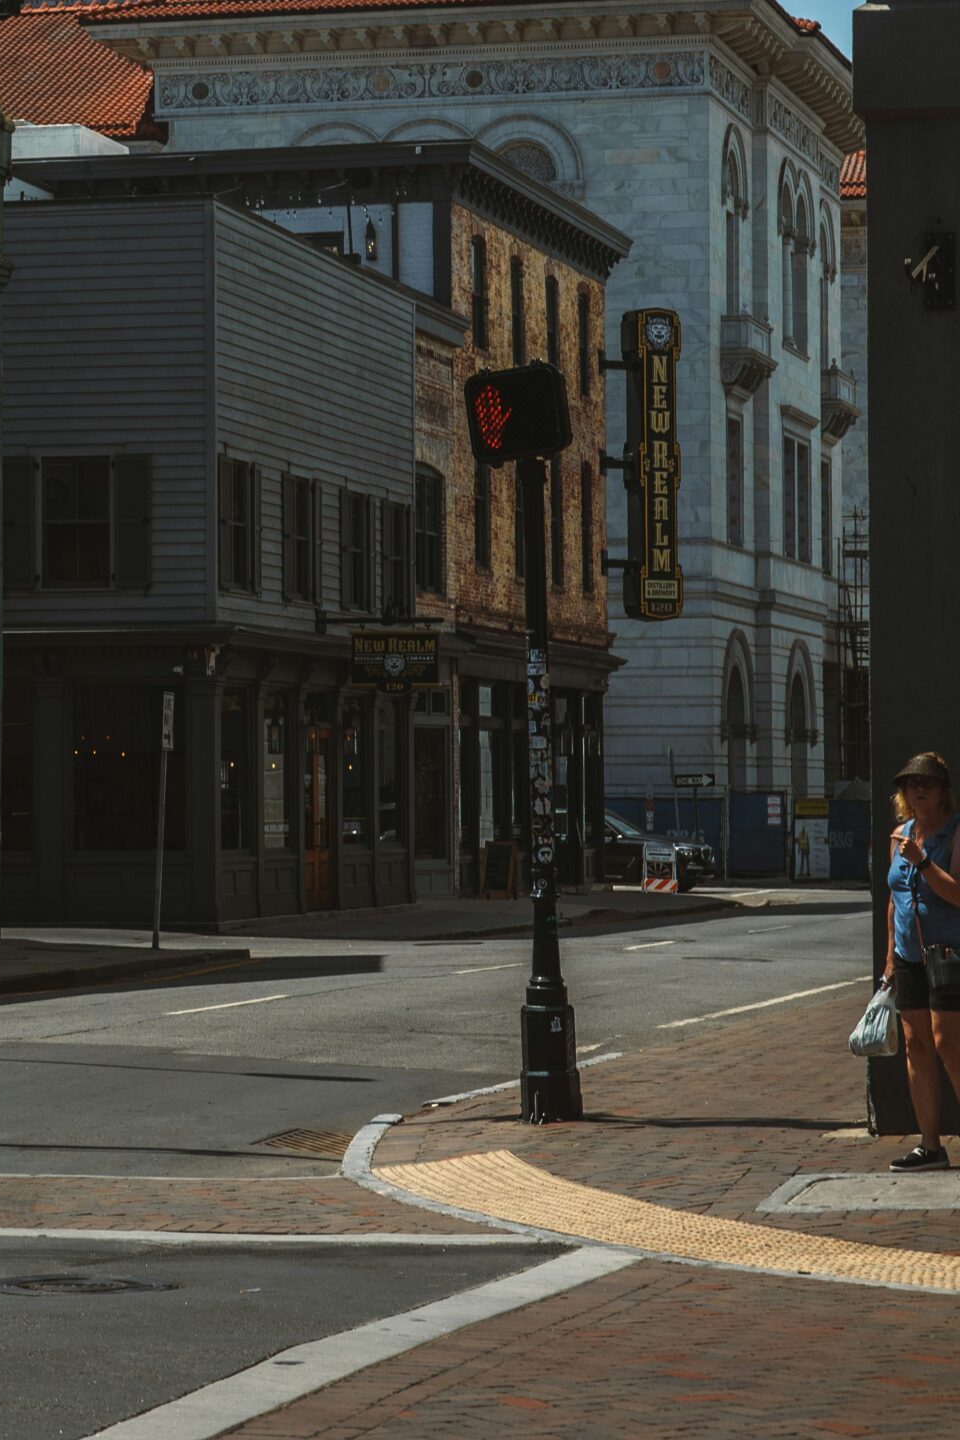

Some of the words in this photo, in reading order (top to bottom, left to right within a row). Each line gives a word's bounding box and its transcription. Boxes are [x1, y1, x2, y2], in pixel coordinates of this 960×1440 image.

[651, 355, 670, 434] NEW
[653, 440, 671, 573] REALM
[354, 638, 385, 653] NEW
[388, 637, 436, 653] REALM
[385, 682, 404, 691] 120
[164, 696, 173, 712] ONE
[163, 712, 173, 733] WAY
[691, 776, 703, 784] WAY
[829, 830, 854, 849] B&G
